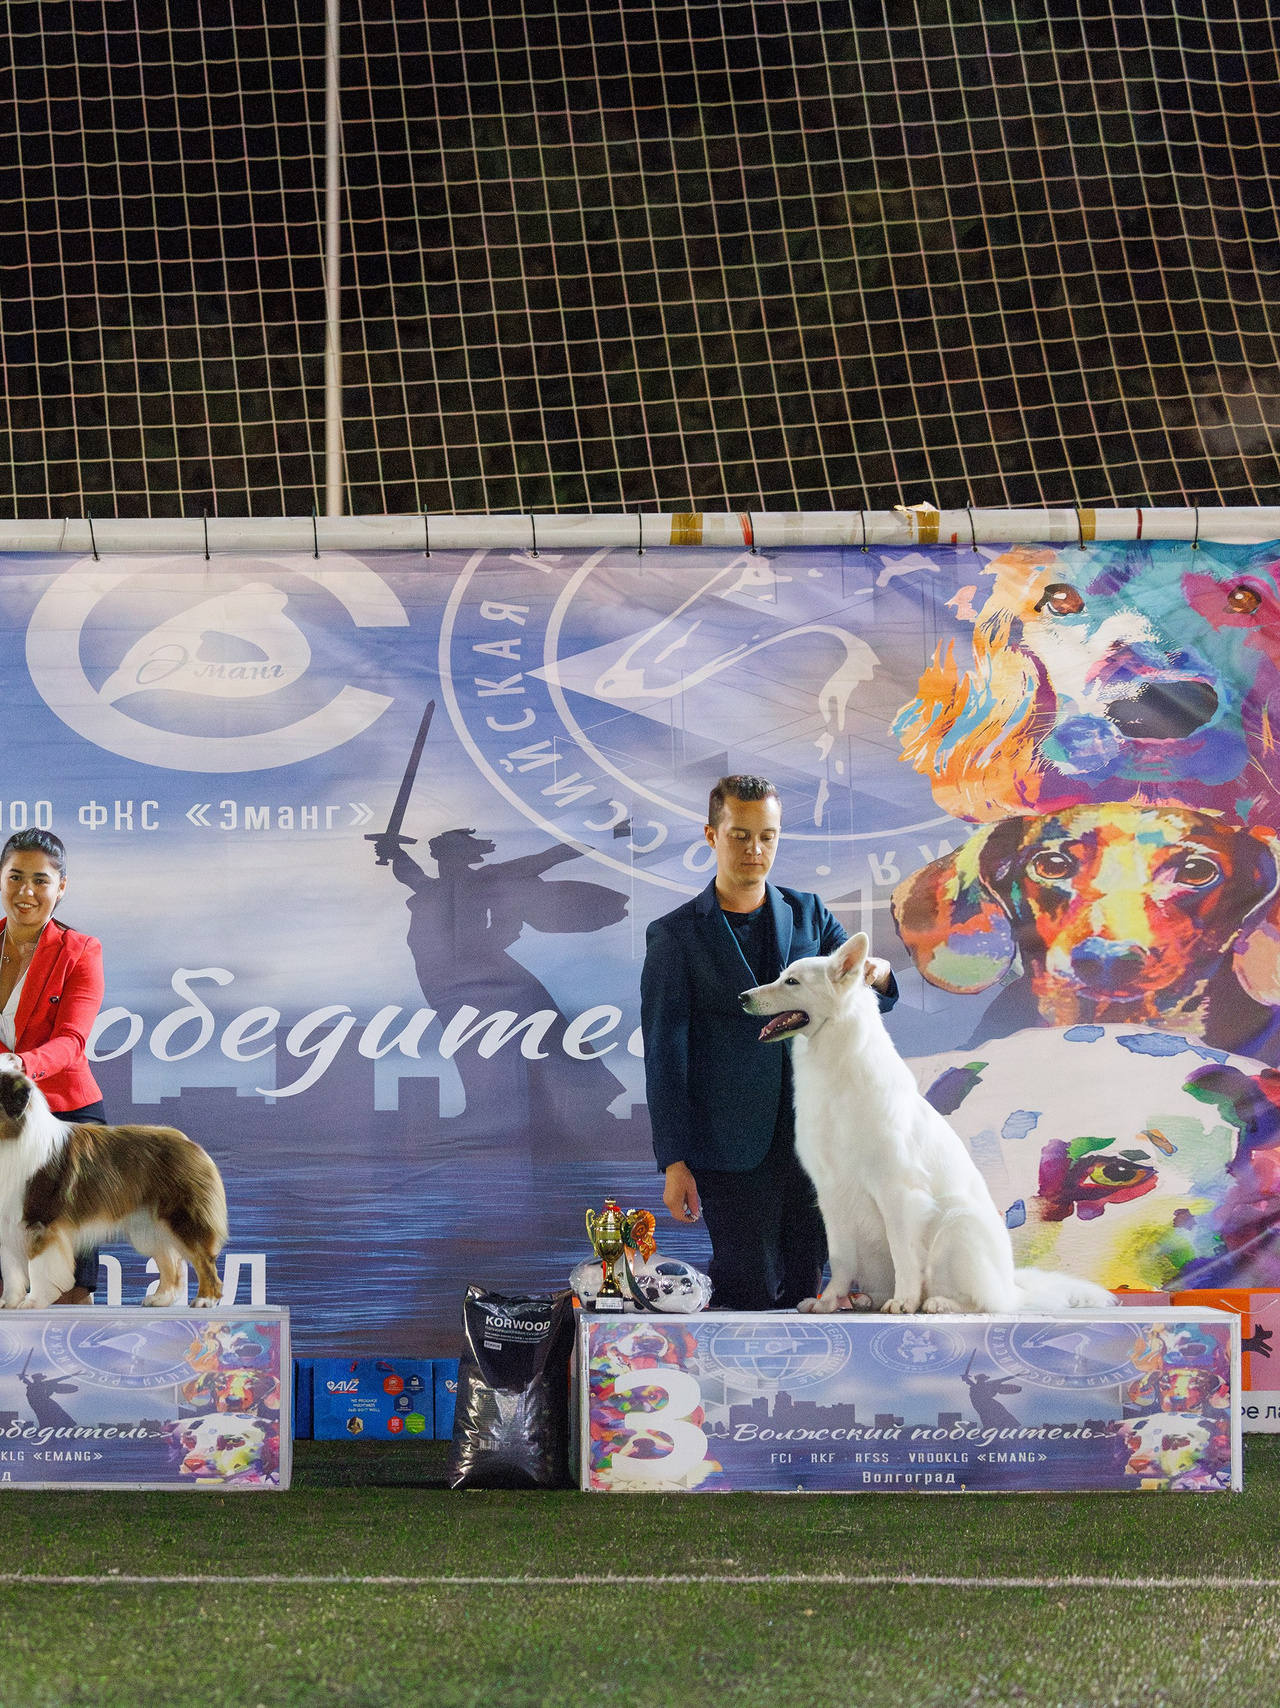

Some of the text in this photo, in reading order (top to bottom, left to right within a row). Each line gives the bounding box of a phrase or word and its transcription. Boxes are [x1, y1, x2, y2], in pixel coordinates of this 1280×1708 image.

[472, 599, 717, 874] ОССИЙСКАЯ
[78, 801, 159, 831] ФКС
[185, 801, 376, 831] «Эманг»
[85, 967, 645, 1097] обедите
[485, 1315, 551, 1332] KORWOOD
[331, 1379, 359, 1391] AVZ
[610, 1368, 708, 1483] 3
[707, 1421, 1118, 1447] «Волжский победитель»
[33, 1451, 103, 1462] «EMANG»
[771, 1452, 1047, 1464] FCI RKF RFSS VROOKLG «EMANG»
[862, 1471, 956, 1485] Волгоград
